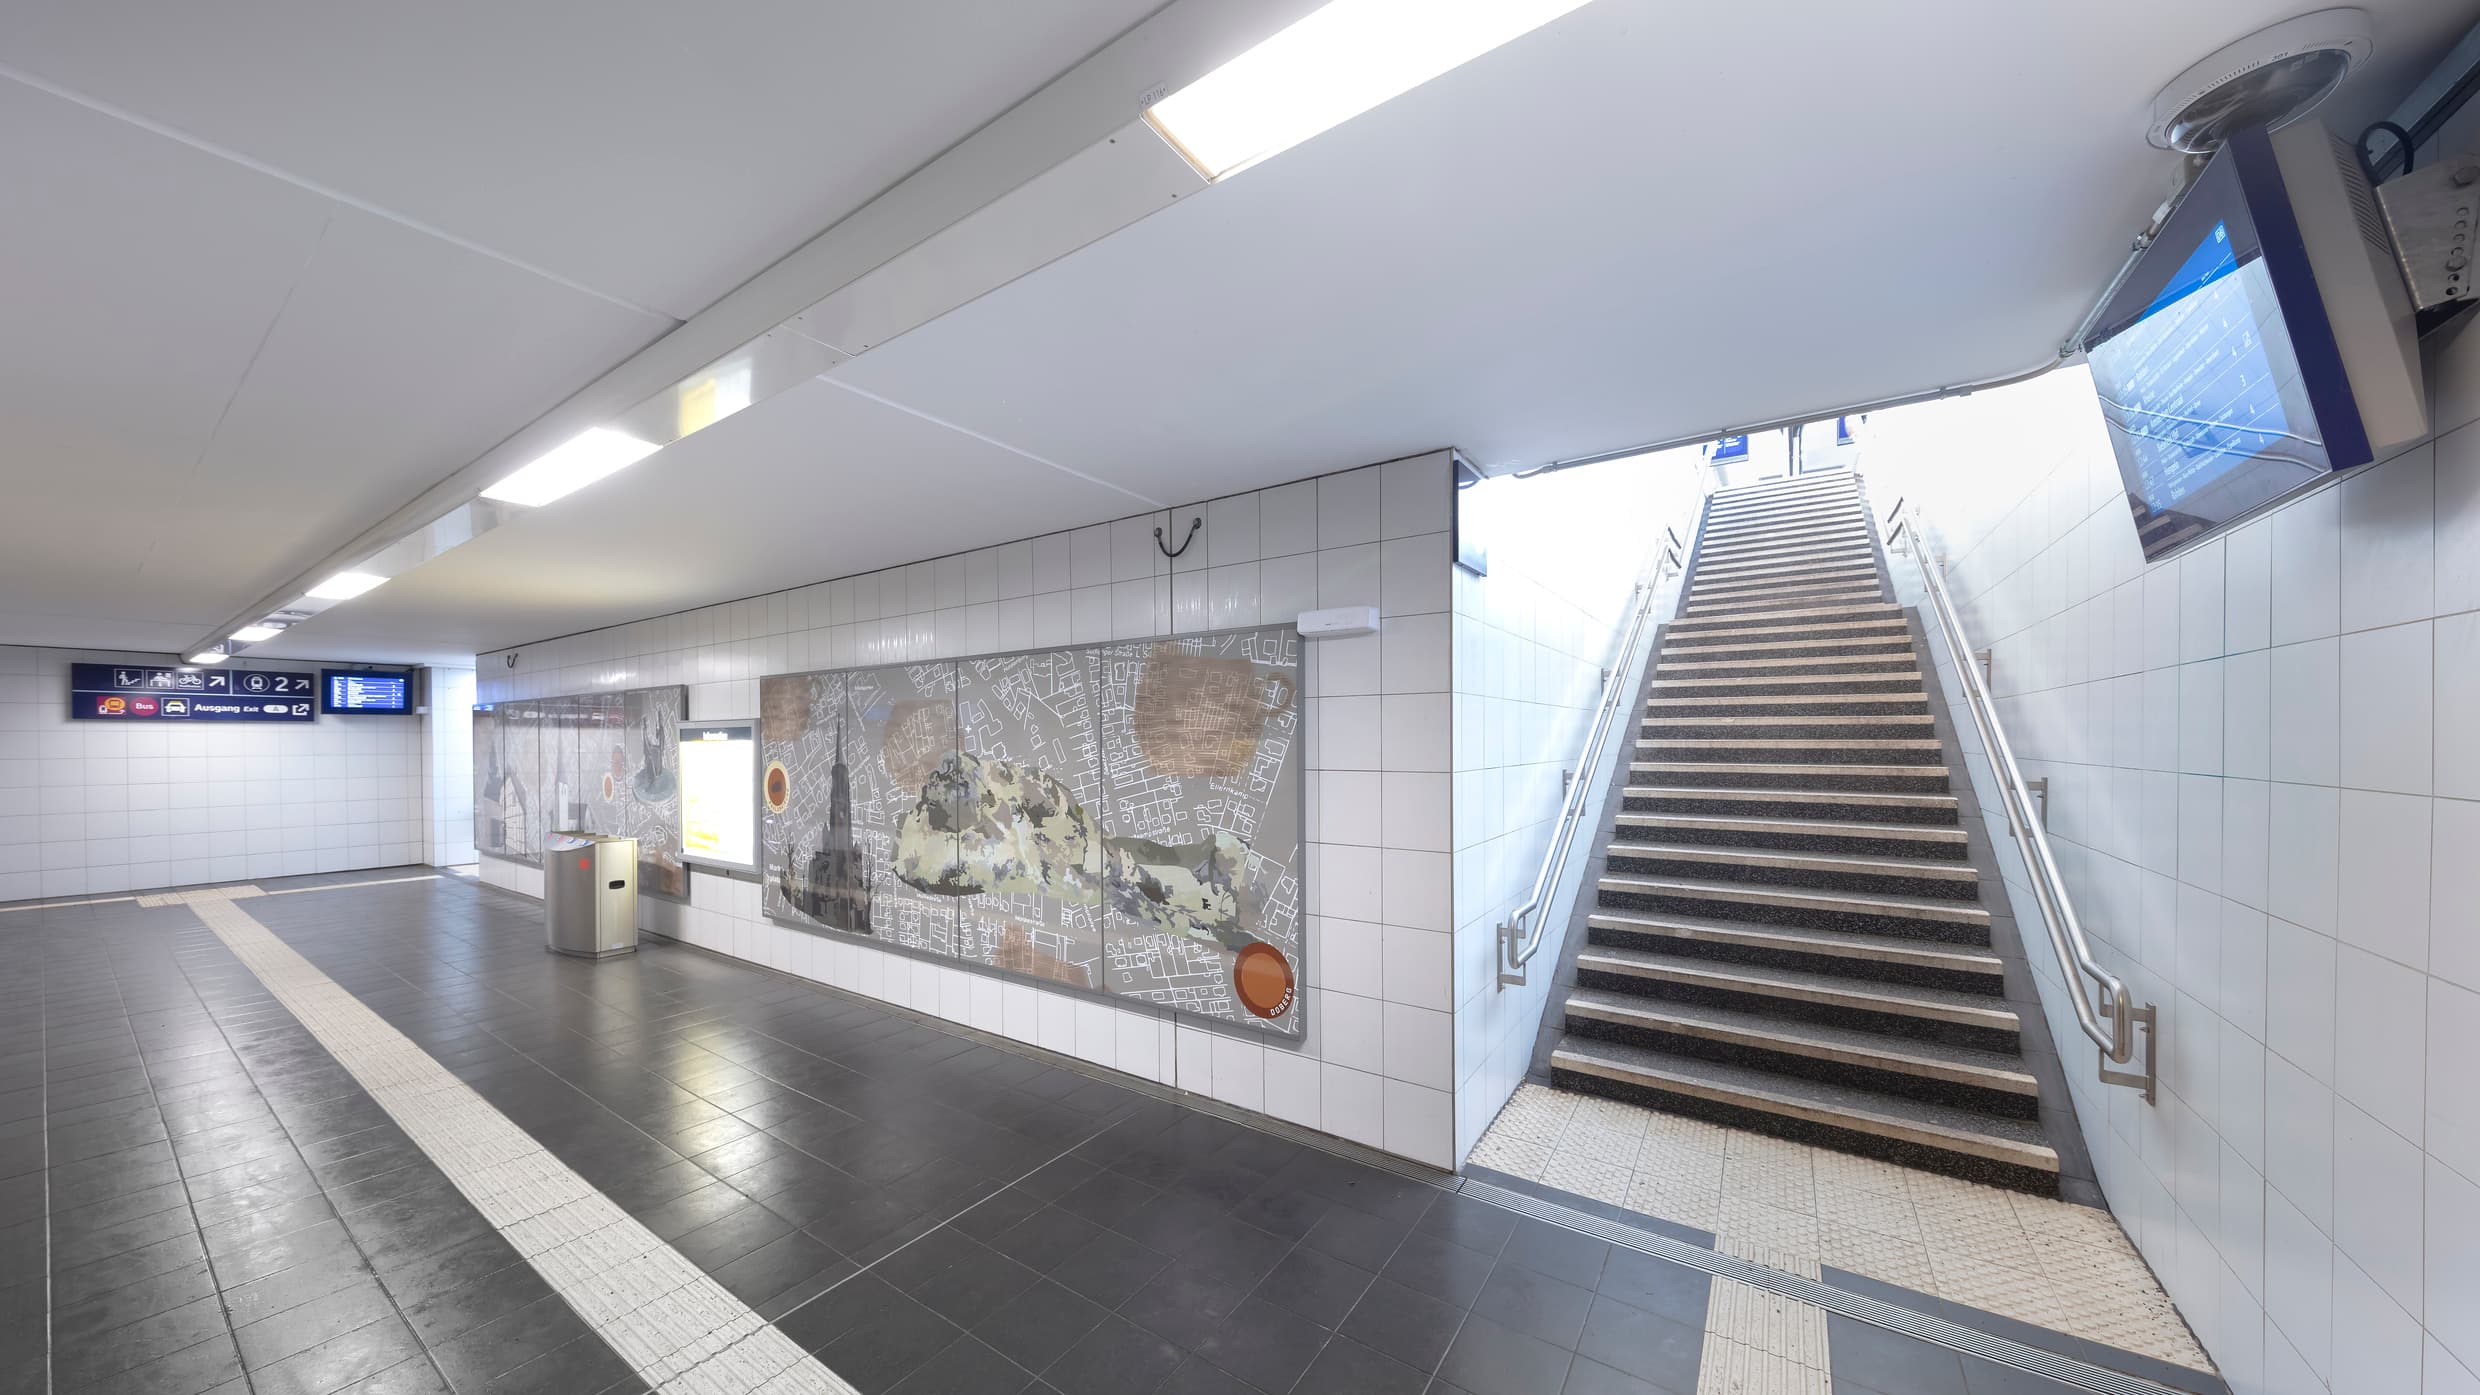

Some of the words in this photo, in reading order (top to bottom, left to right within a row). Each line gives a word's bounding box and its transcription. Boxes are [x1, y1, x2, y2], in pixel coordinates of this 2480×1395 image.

[275, 677, 289, 692] 2
[135, 701, 154, 711] Bus
[194, 703, 241, 714] Ausgang
[243, 705, 259, 713] Exit
[1270, 987, 1292, 1016] DOBERG
